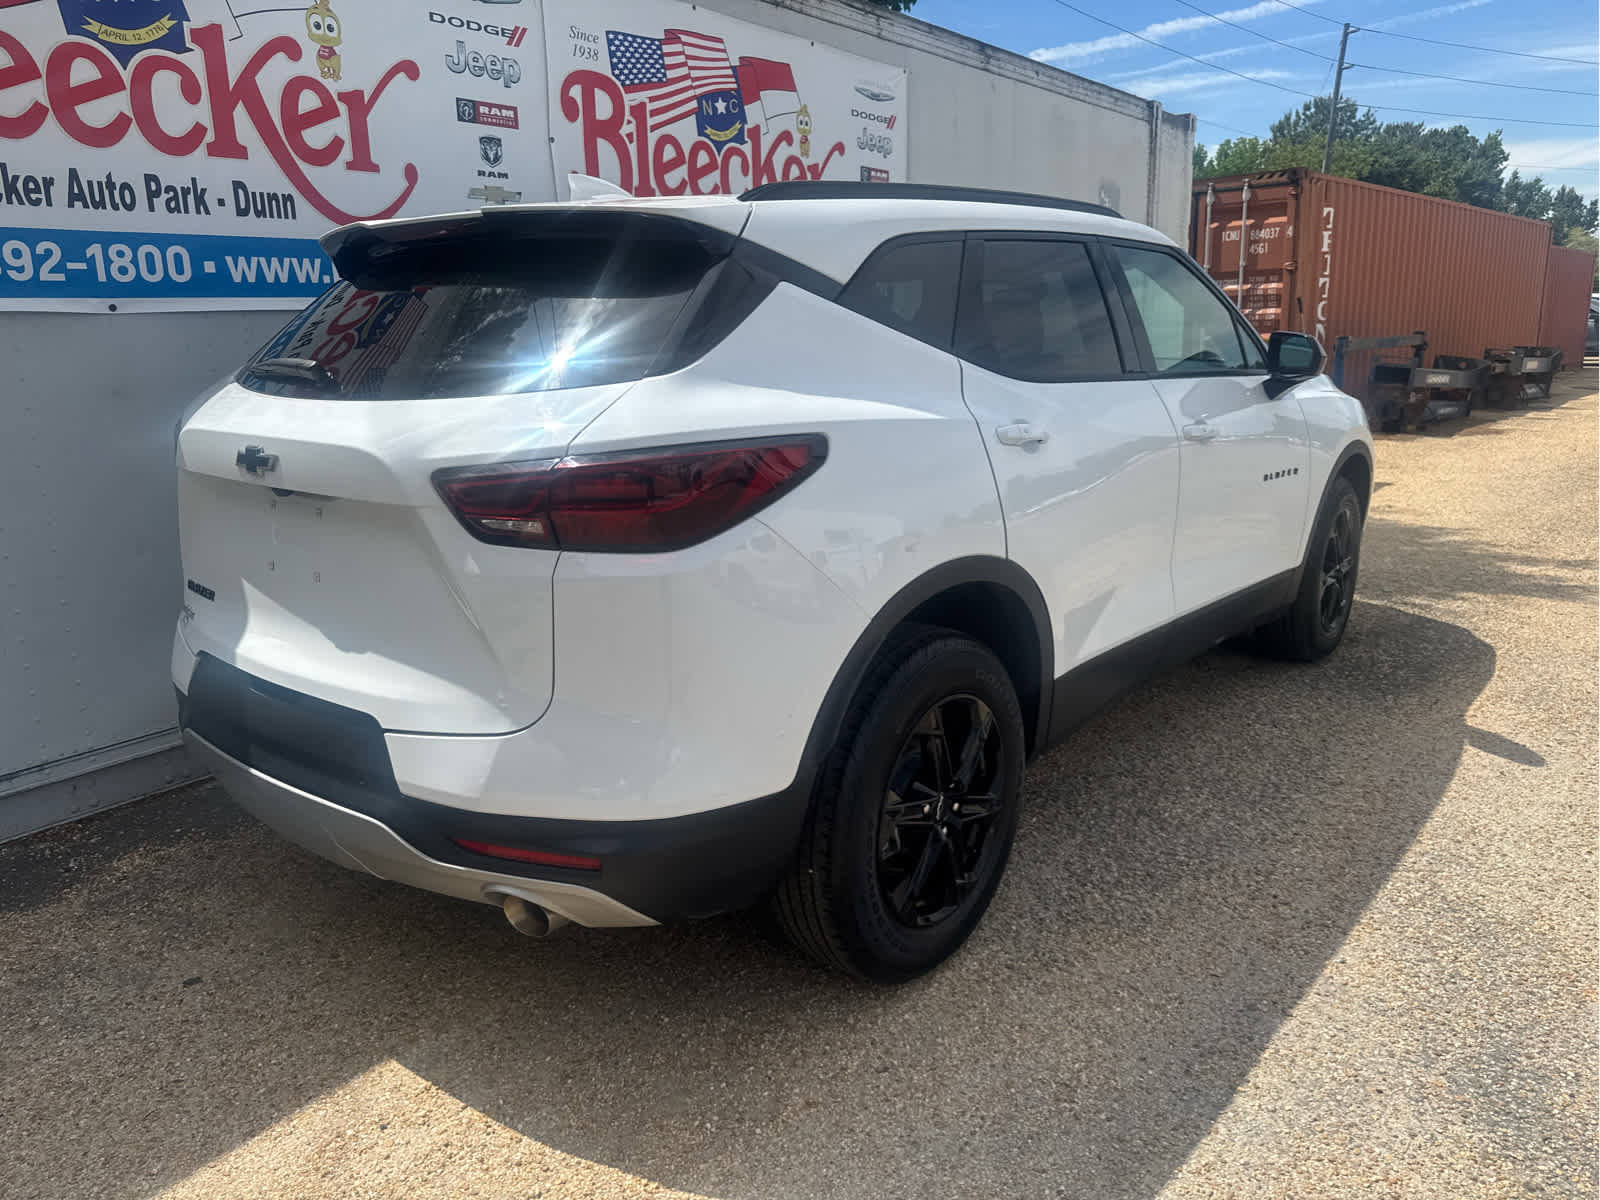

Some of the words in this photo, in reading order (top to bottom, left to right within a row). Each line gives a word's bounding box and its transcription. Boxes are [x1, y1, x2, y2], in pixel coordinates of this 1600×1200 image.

[101, 28, 127, 41] APRIL
[145, 25, 164, 37] 1776
[429, 12, 514, 39] DODGE
[569, 25, 599, 44] Since
[572, 43, 599, 62] 1938
[445, 40, 521, 88] Jeep
[479, 105, 515, 119] RAM
[702, 98, 713, 116] N
[729, 98, 739, 114] C
[851, 109, 890, 124] DODGE
[561, 70, 845, 197] Bleecker
[856, 127, 893, 159] Jeep
[477, 169, 509, 180] RAM
[0, 162, 54, 207] ker
[68, 167, 137, 212] Auto
[144, 173, 211, 216] Park
[232, 180, 297, 220] Dunn
[0, 239, 192, 283] 92-1800
[225, 255, 340, 284] www.
